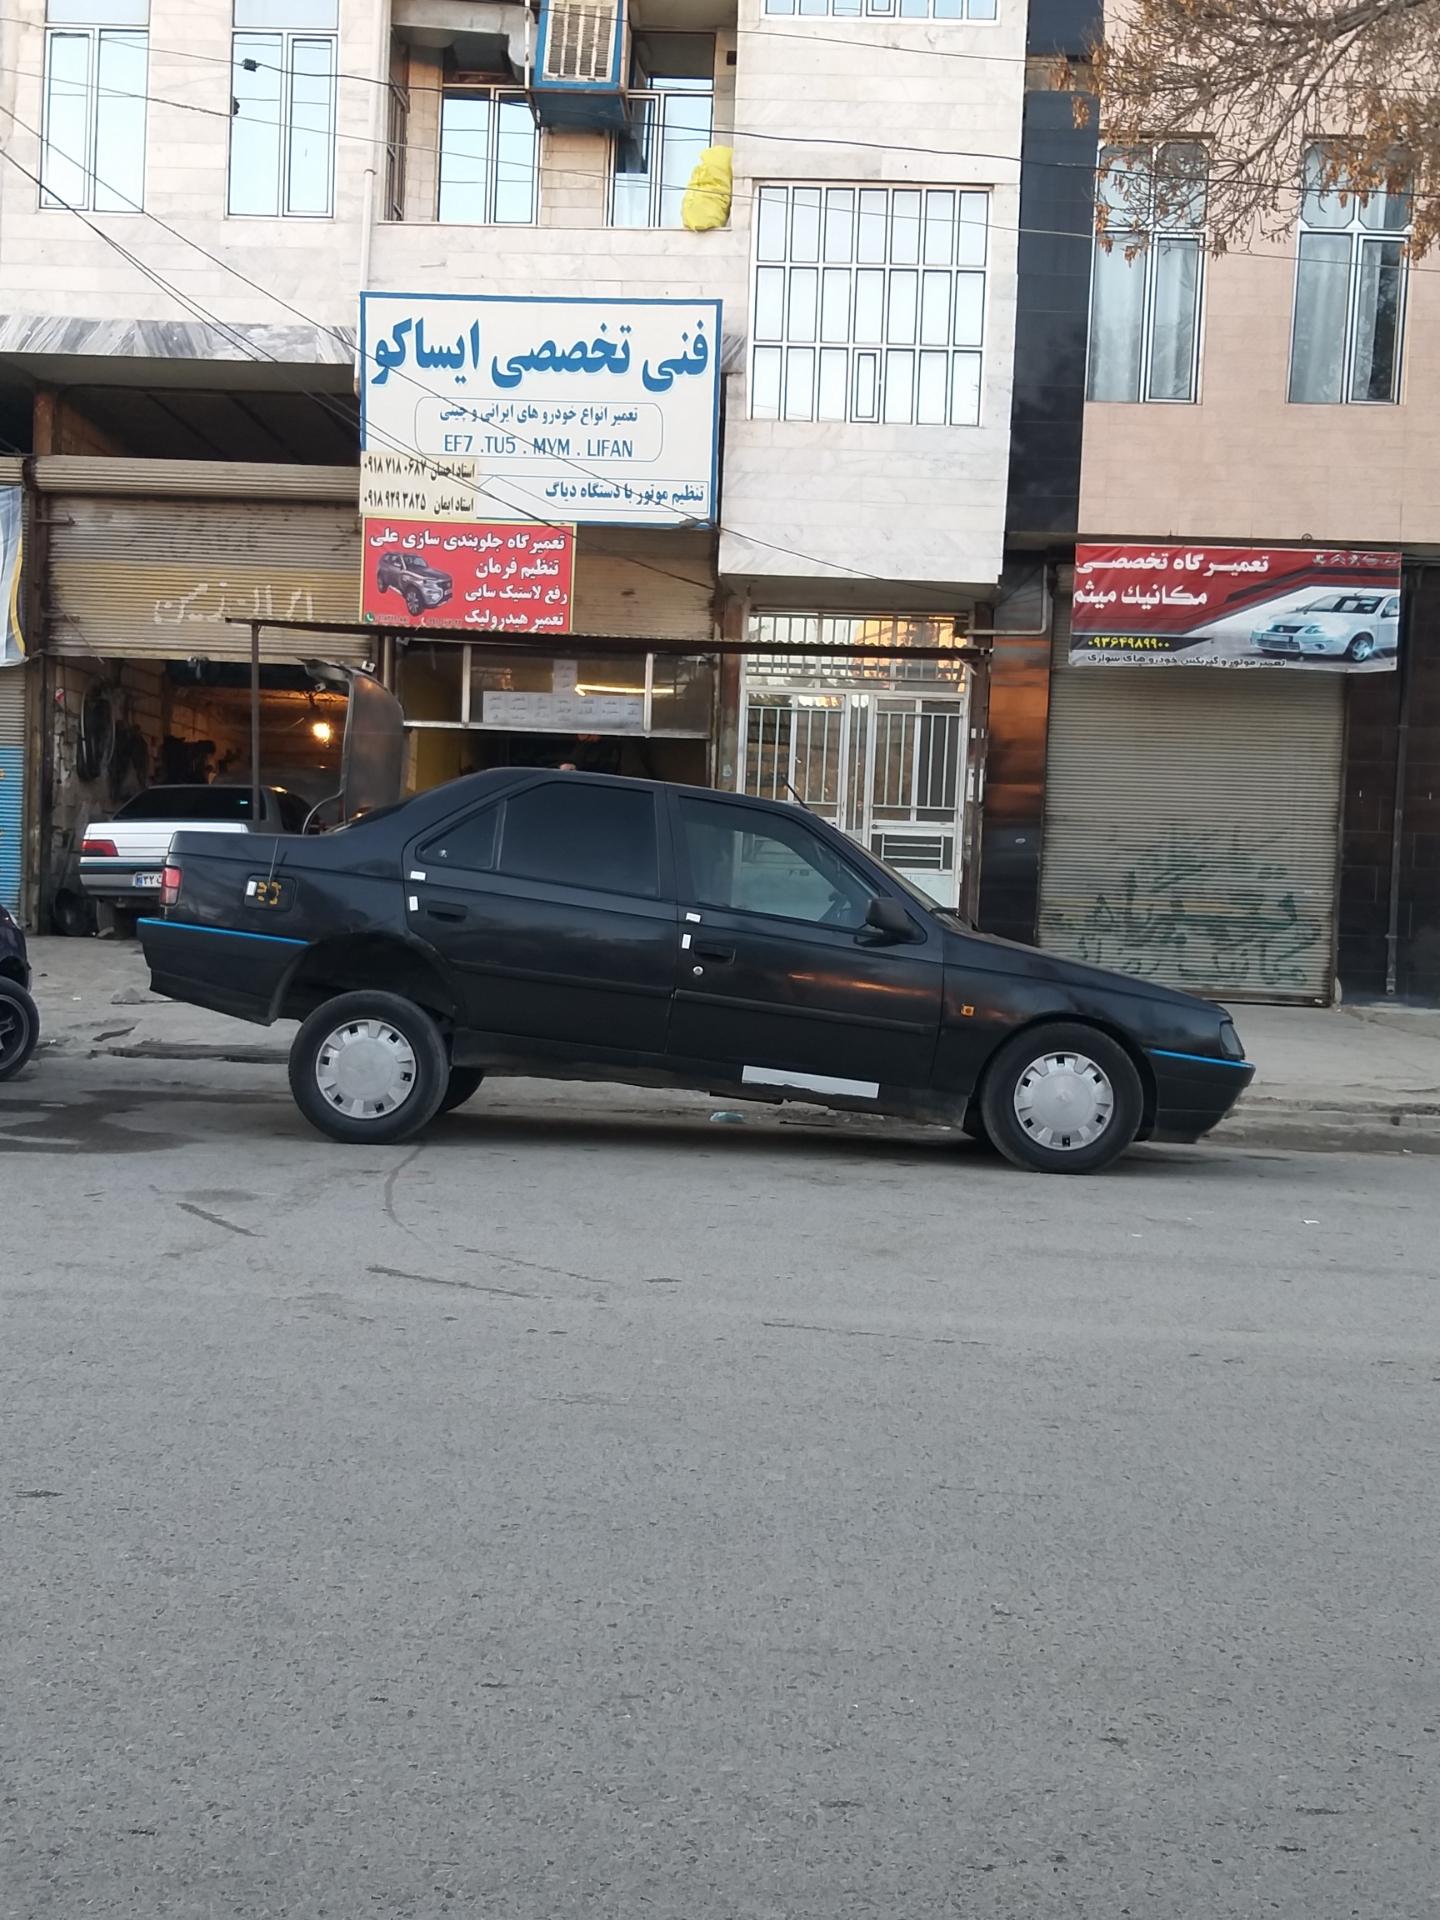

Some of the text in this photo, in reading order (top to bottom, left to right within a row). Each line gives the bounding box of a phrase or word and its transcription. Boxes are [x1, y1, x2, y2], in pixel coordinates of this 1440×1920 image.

[371, 317, 709, 392] فنی تخصصی ایساکو
[480, 403, 514, 423] ایرانی
[580, 407, 608, 426] انواع
[610, 406, 638, 426] تعمیر
[444, 434, 473, 453] EF7
[533, 437, 571, 457] MVM
[587, 440, 633, 458] LIFAN
[545, 480, 704, 505] تنظیم موتور با دستگاه دیاگ
[370, 528, 399, 546] علی
[402, 529, 440, 549] سازی
[443, 532, 504, 553] جلوبندی
[475, 556, 559, 580] تنظیم فرمان
[1075, 552, 1169, 574] تخصصی
[498, 584, 542, 604] لاستیک
[544, 586, 568, 605] رفع
[1072, 579, 1118, 609] میثم
[464, 609, 529, 631] هیدرولیک
[528, 611, 565, 633] تعمیر
